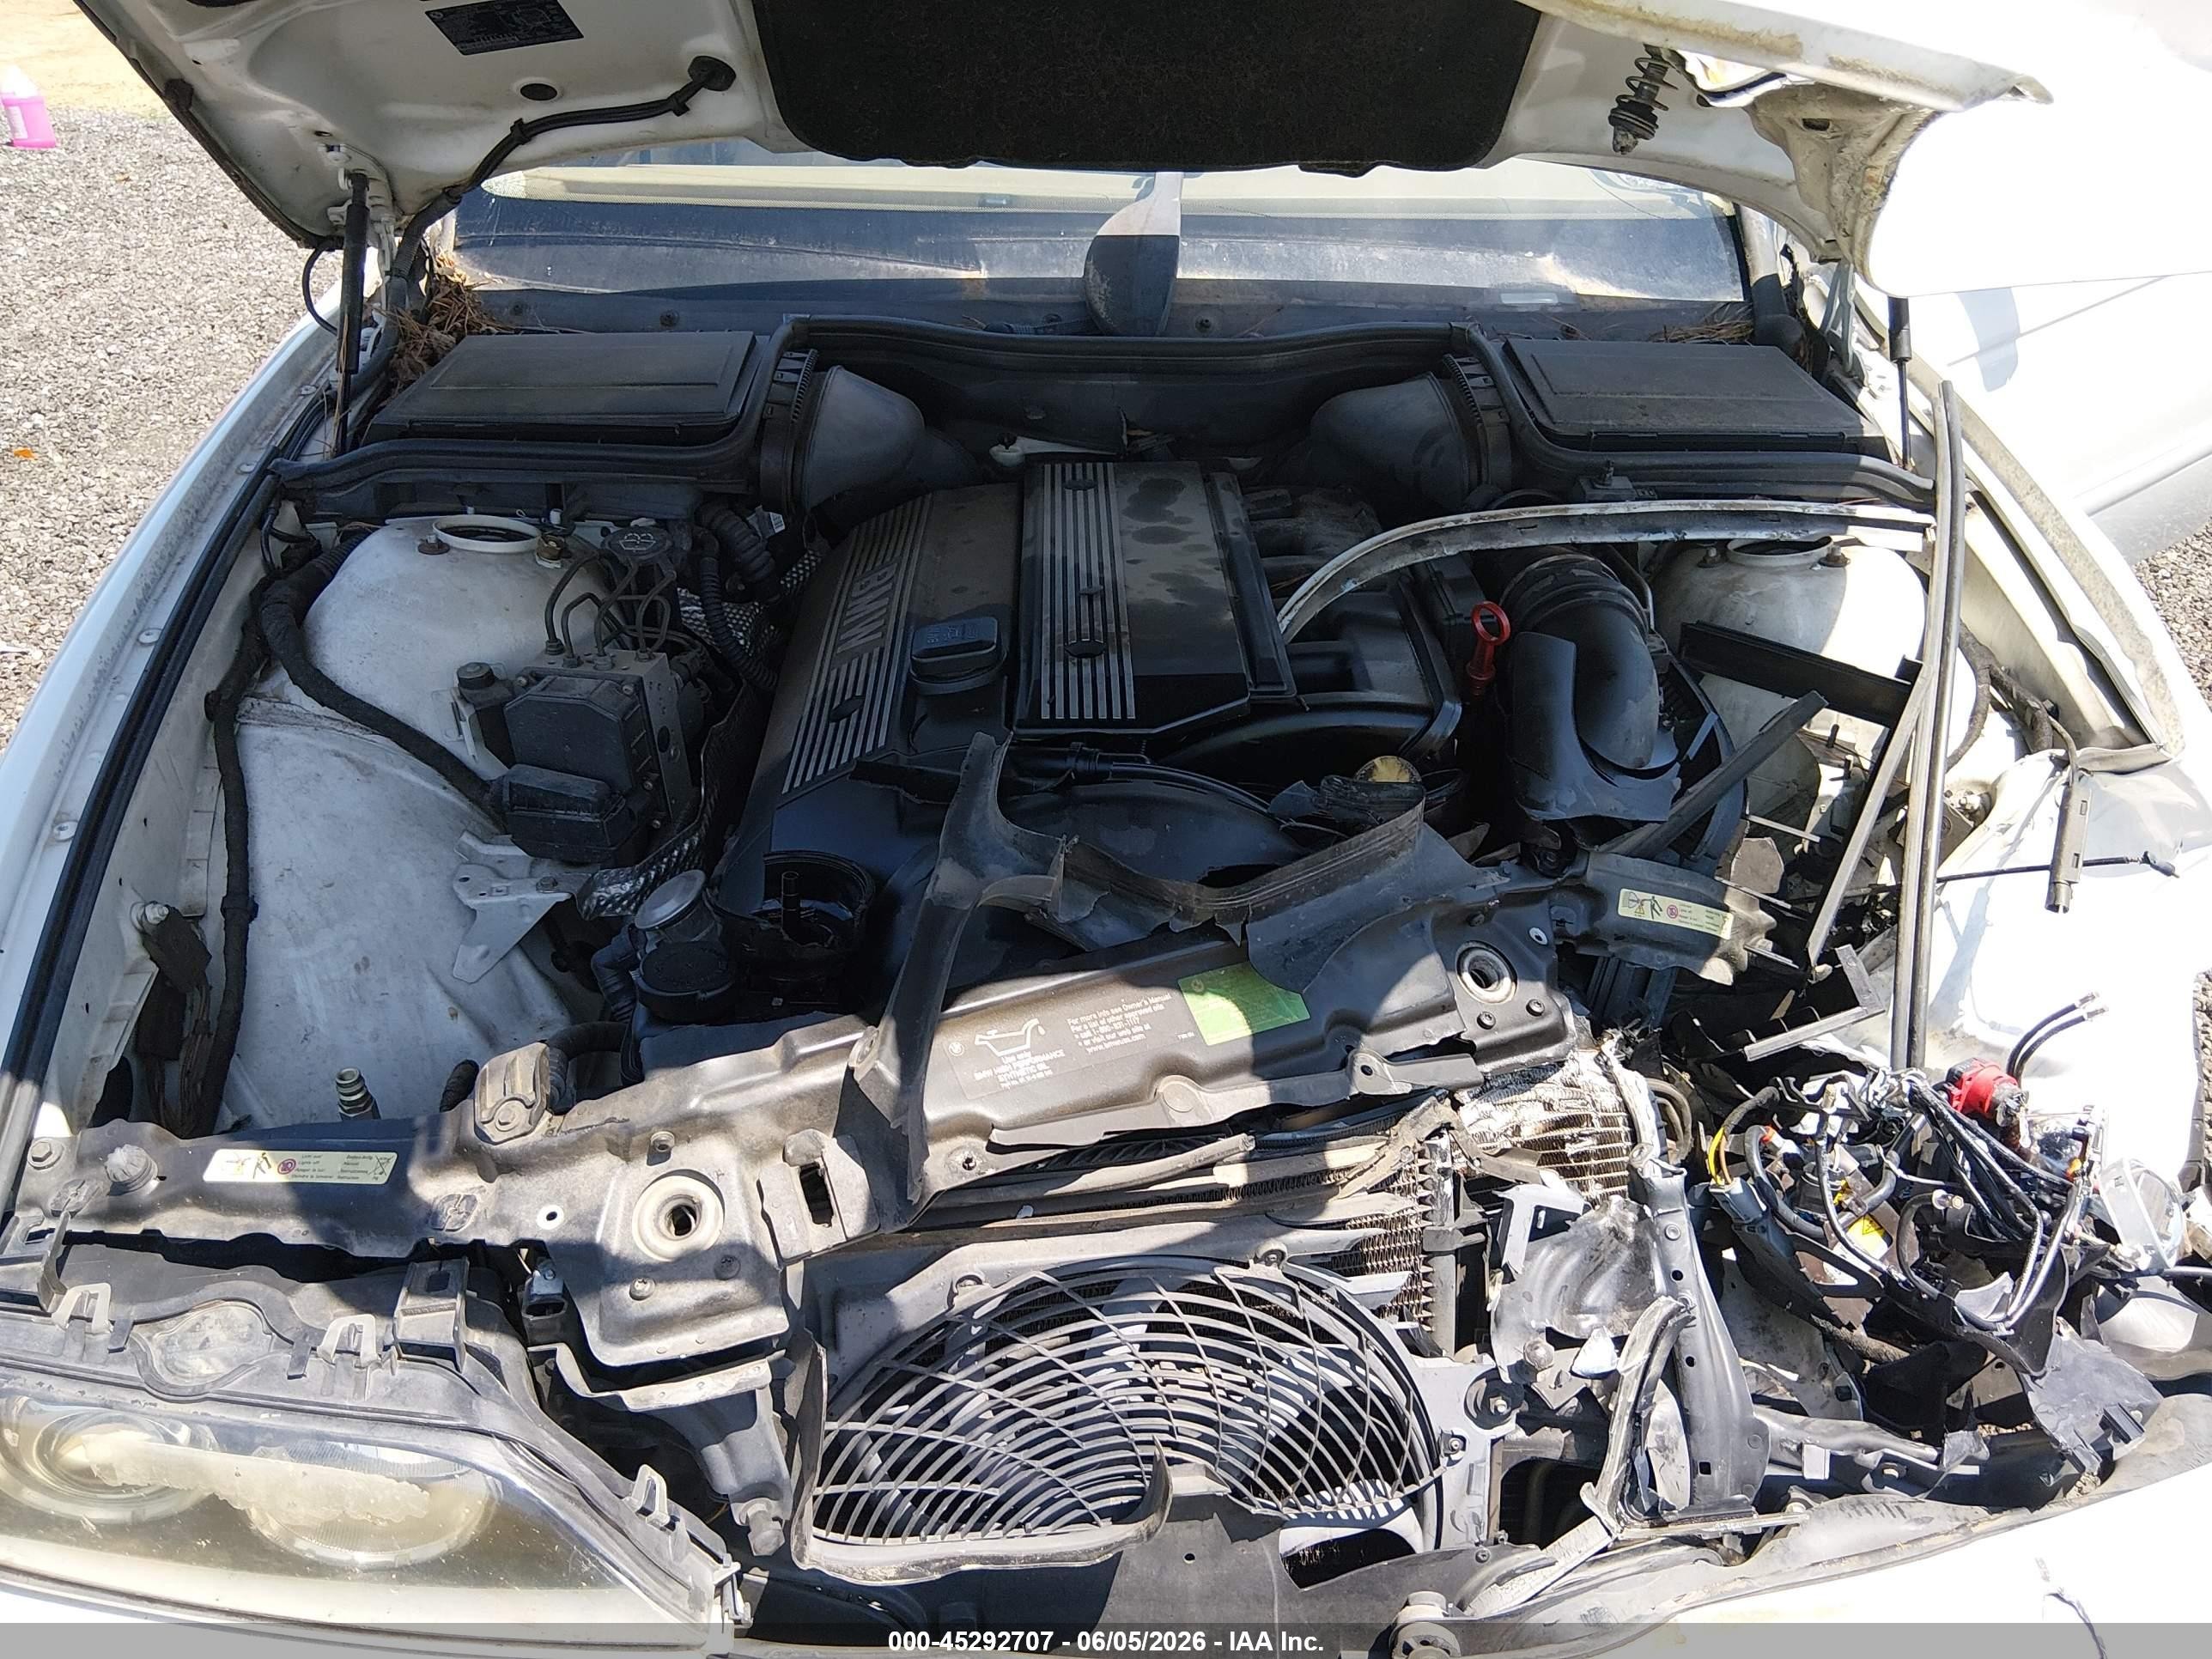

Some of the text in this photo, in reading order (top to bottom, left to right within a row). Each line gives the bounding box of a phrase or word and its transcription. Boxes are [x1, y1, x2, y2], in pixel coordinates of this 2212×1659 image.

[836, 562, 898, 654] BMW
[1109, 1006, 1122, 1015] see
[1121, 1000, 1149, 1012] Owner's
[1147, 993, 1172, 1005] Manual
[1070, 1024, 1083, 1033] For
[1088, 1019, 1100, 1029] list
[1106, 1014, 1123, 1024] other
[1123, 1006, 1153, 1019] approved
[1152, 1003, 1165, 1012] oils
[1091, 1035, 1106, 1044] visit
[1117, 1028, 1132, 1038] web
[1131, 1025, 1144, 1034] site
[1012, 1049, 1066, 1070] PERFORMANCE
[997, 1065, 1037, 1083] SYNTHETIC
